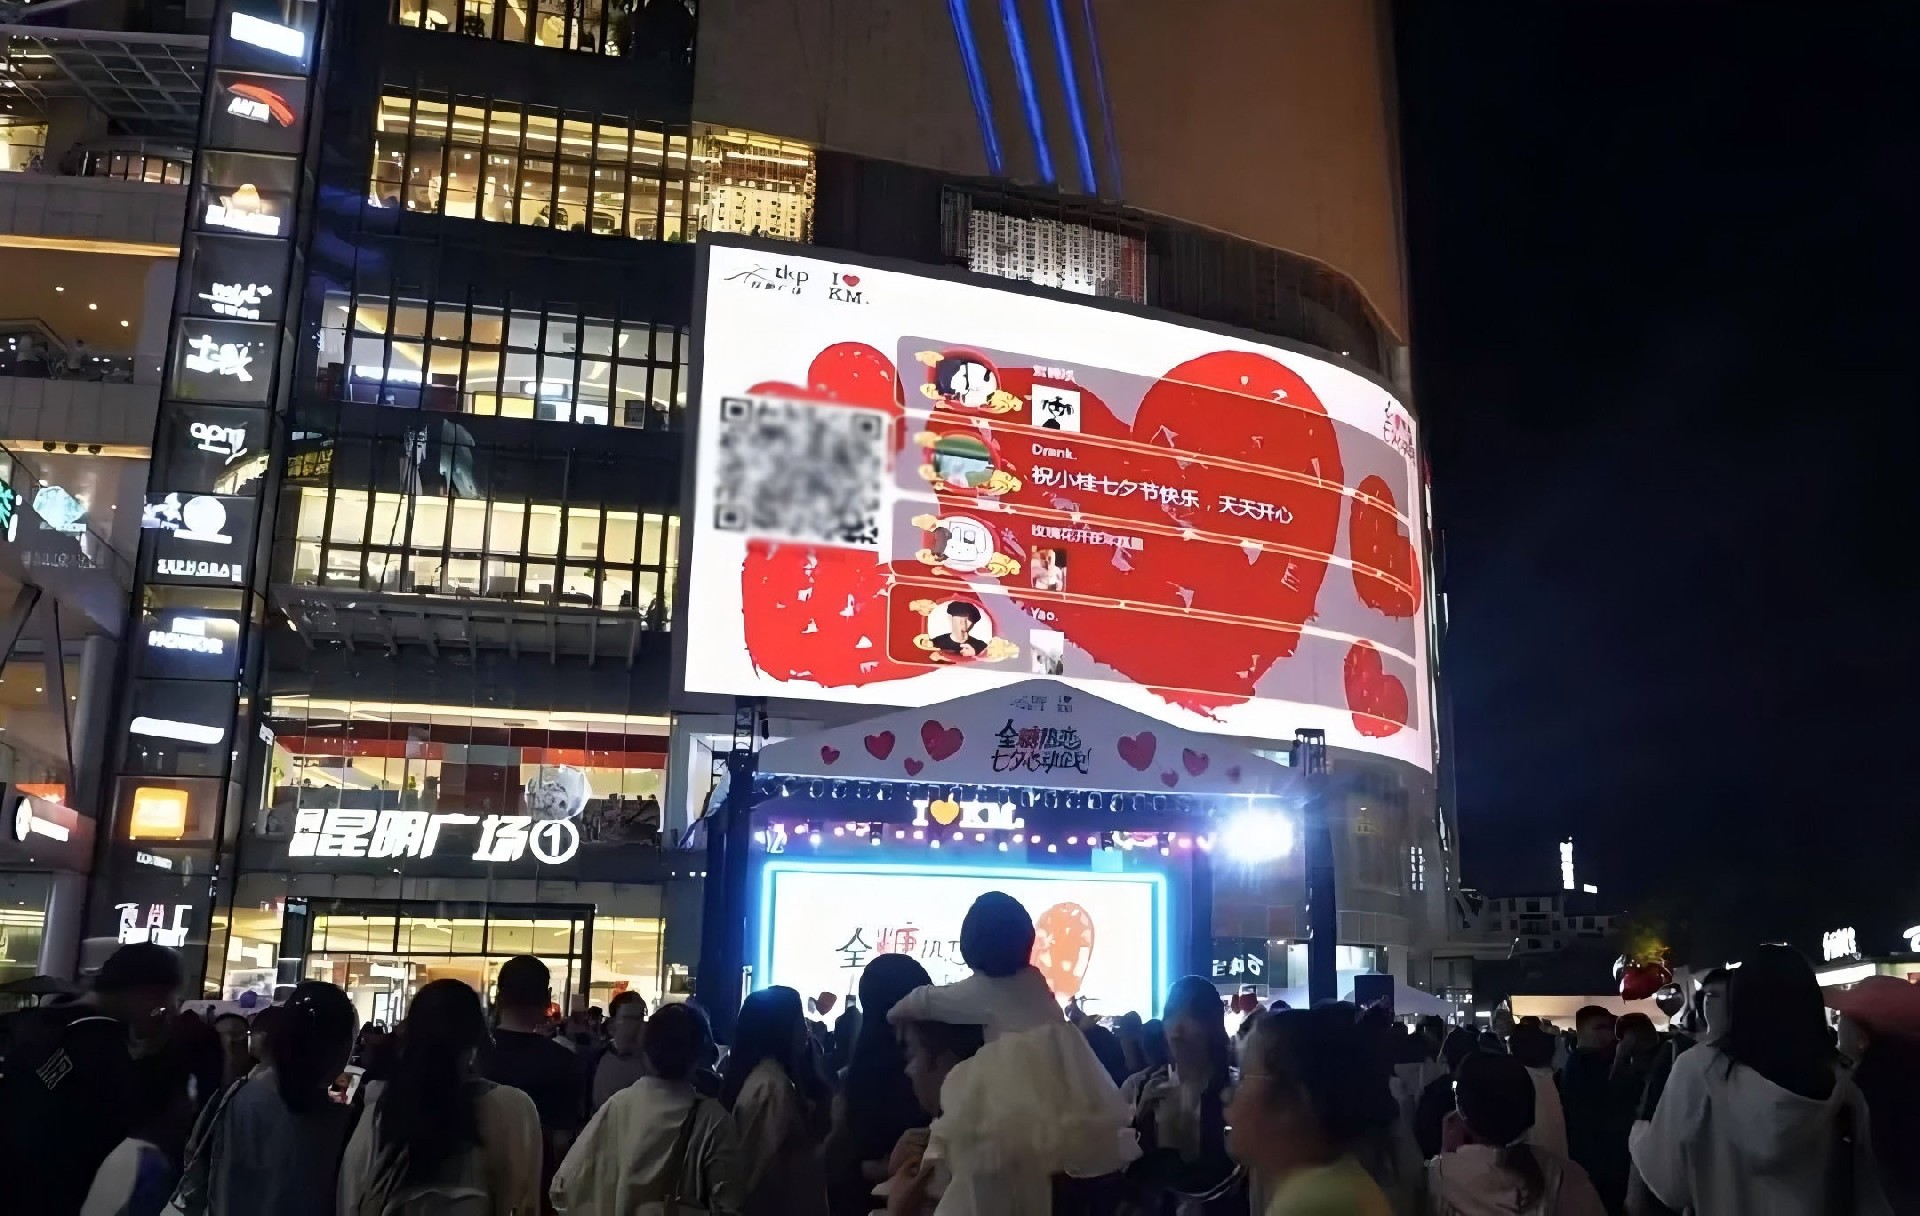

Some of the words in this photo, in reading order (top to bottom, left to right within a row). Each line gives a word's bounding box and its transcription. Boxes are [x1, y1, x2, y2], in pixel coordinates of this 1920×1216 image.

[832, 271, 840, 286] I
[1031, 465, 1294, 525] 祝小桂七夕节快乐，天天开心
[912, 799, 929, 827] I
